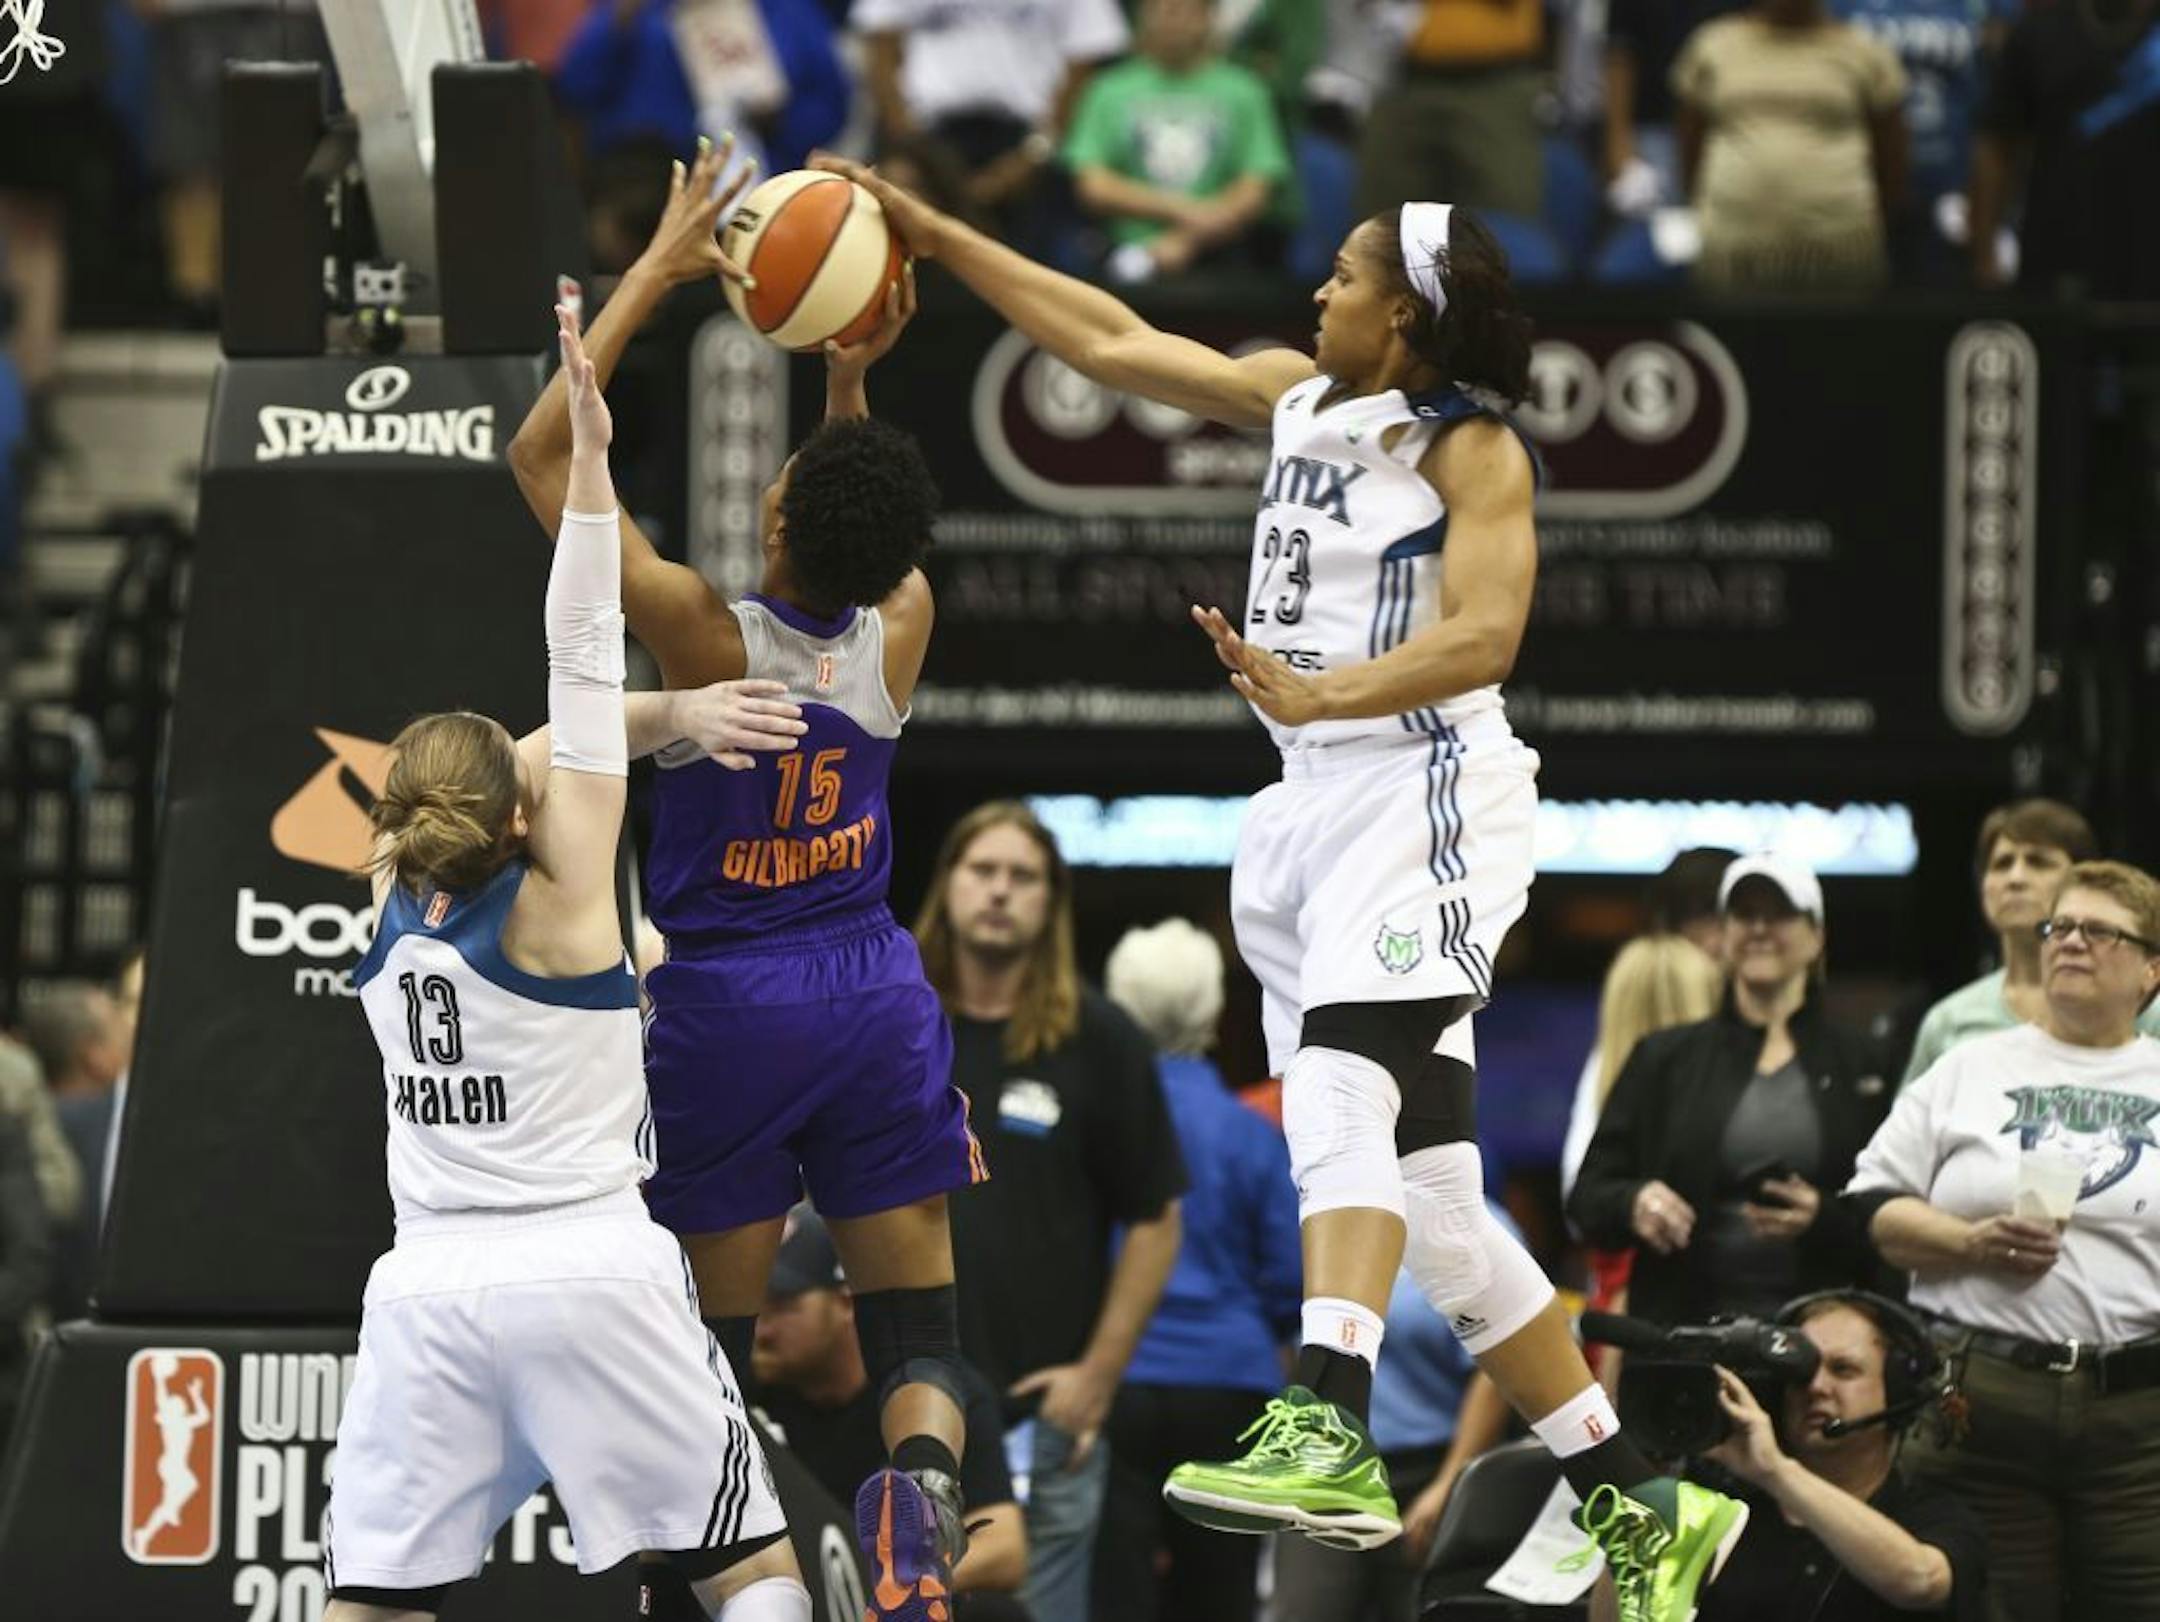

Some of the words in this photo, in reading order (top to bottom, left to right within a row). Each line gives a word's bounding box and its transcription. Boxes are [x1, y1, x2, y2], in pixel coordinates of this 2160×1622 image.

[256, 404, 496, 462] SPALDING
[1251, 526, 1311, 626] 23
[773, 747, 847, 831] 15
[398, 972, 464, 1066] 13
[392, 1073, 507, 1125] HaLen
